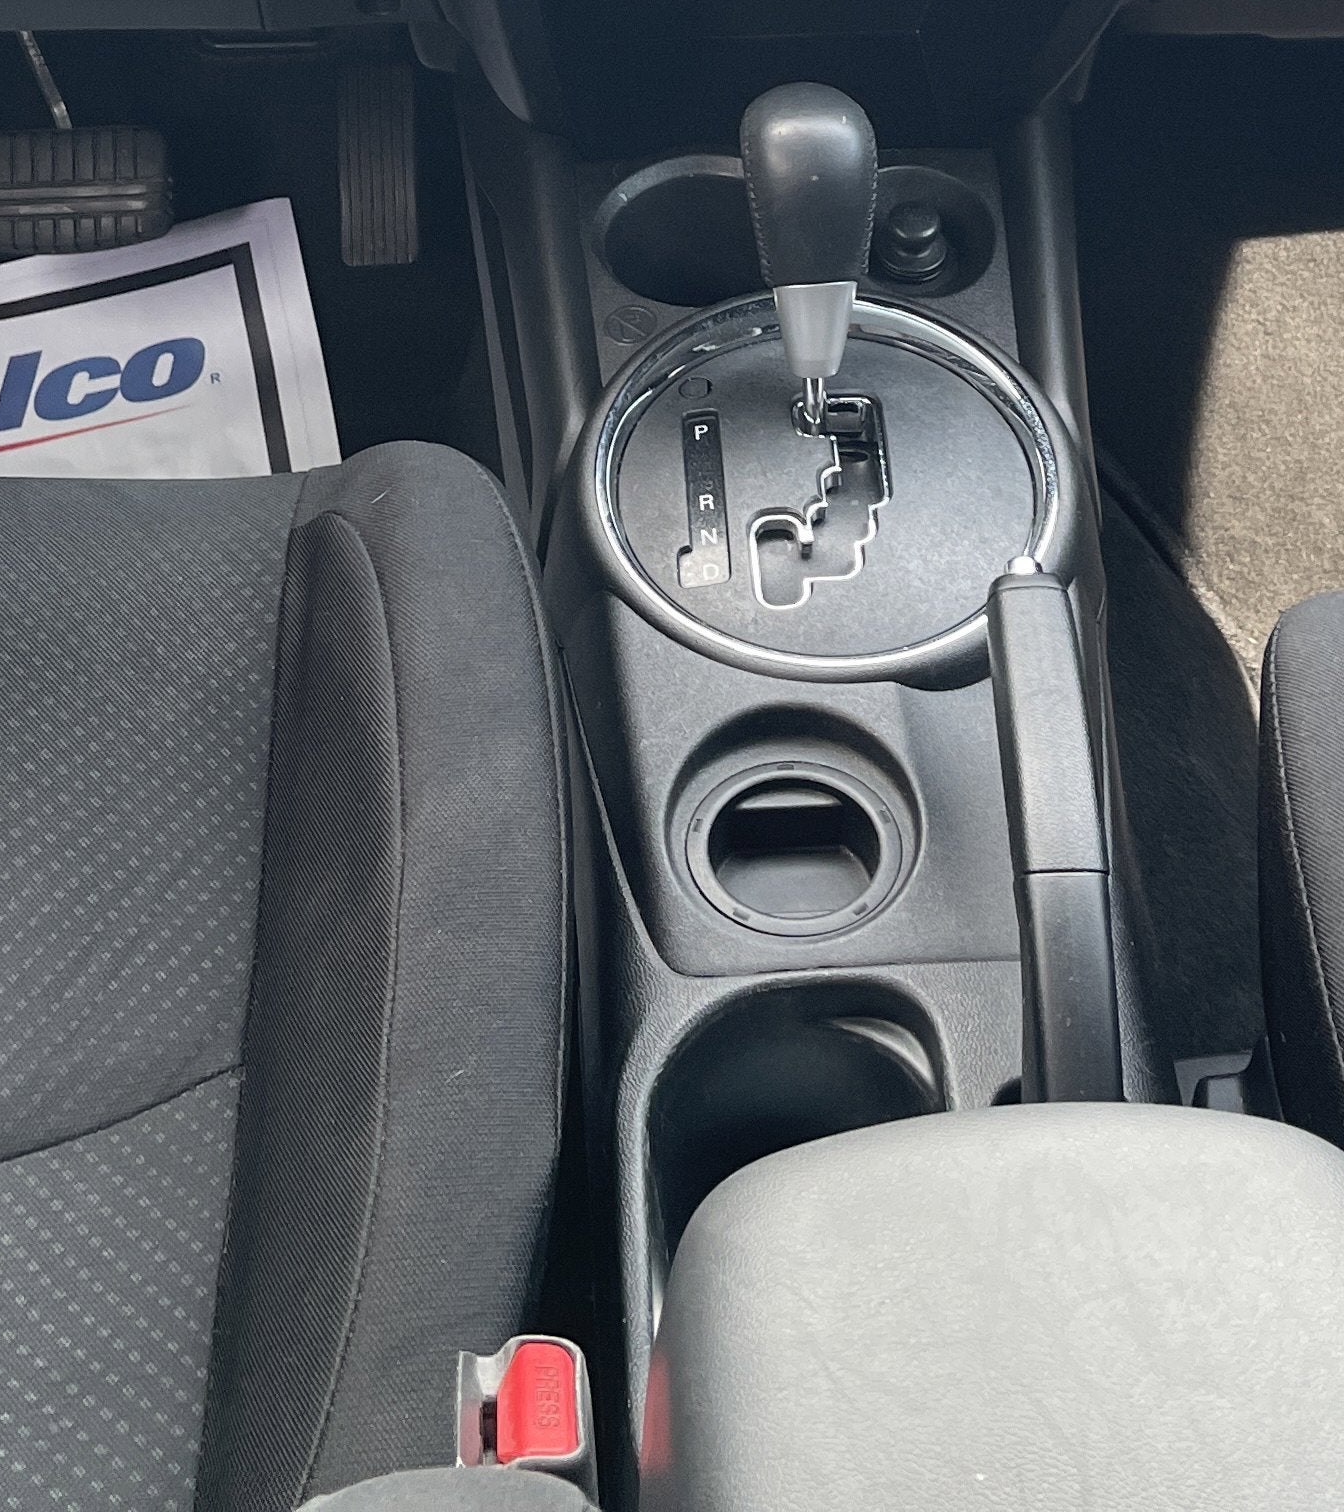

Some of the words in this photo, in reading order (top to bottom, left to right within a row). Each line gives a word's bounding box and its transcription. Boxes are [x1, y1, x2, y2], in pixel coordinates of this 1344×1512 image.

[694, 424, 709, 441] P
[698, 494, 715, 511] R
[700, 527, 718, 546] N
[702, 563, 719, 581] D
[535, 1365, 561, 1430] PRESS
